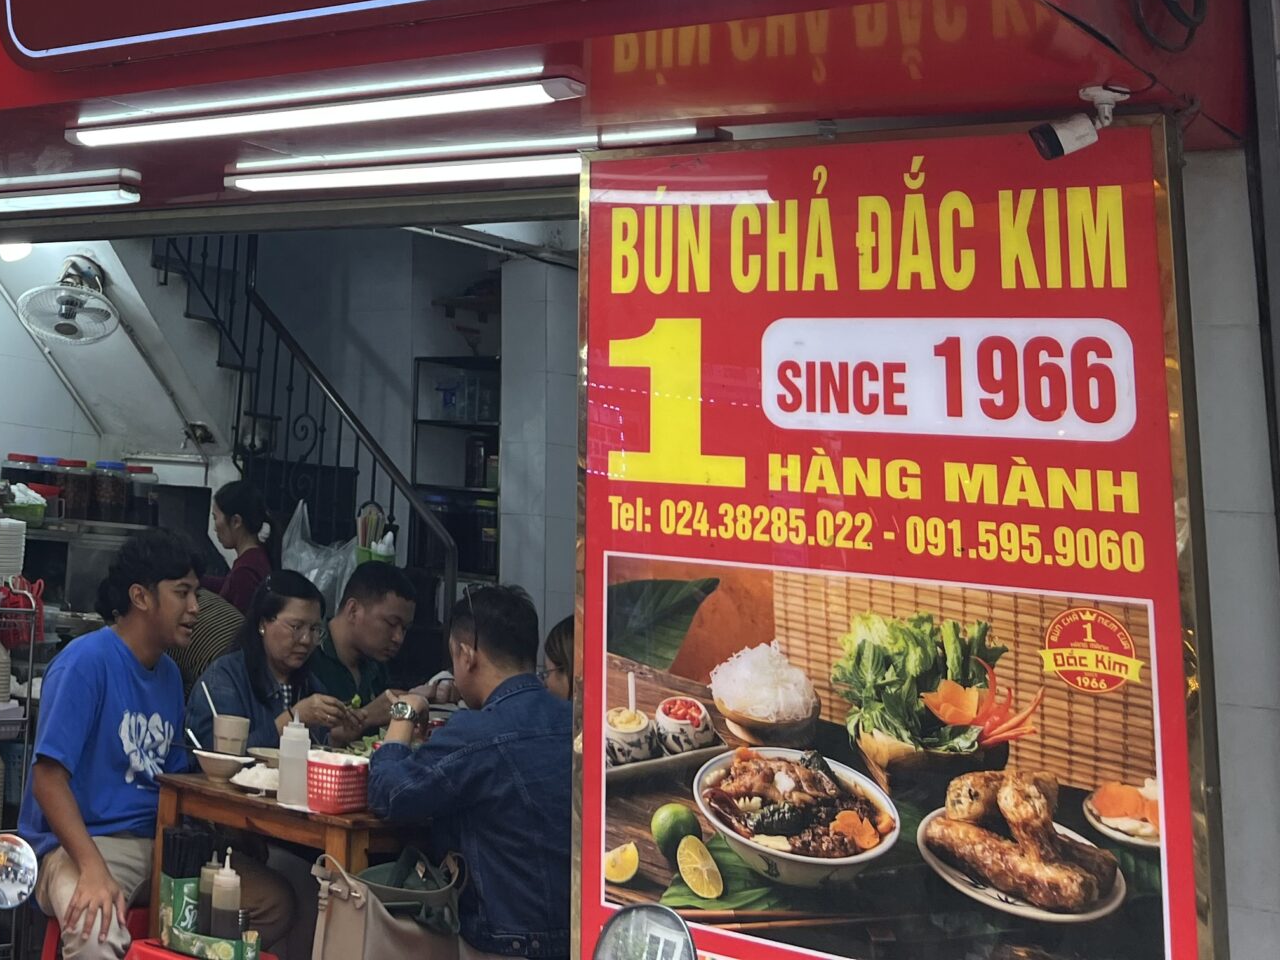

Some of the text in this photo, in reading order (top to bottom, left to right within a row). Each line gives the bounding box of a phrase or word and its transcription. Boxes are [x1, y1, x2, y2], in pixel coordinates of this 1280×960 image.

[610, 155, 1127, 294] BÚN CHẢ ĐẮC KIM
[608, 318, 746, 488] 1
[776, 335, 1118, 425] SINCE 1966
[768, 447, 1140, 514] HÀNG MÀNH
[608, 496, 652, 536] Tel:
[659, 499, 873, 551] 024.38285.022
[906, 523, 1145, 573] 091.595.9060
[1052, 649, 1129, 676] Đắc Kim
[1082, 622, 1097, 643] 1
[1075, 675, 1108, 690] 1966
